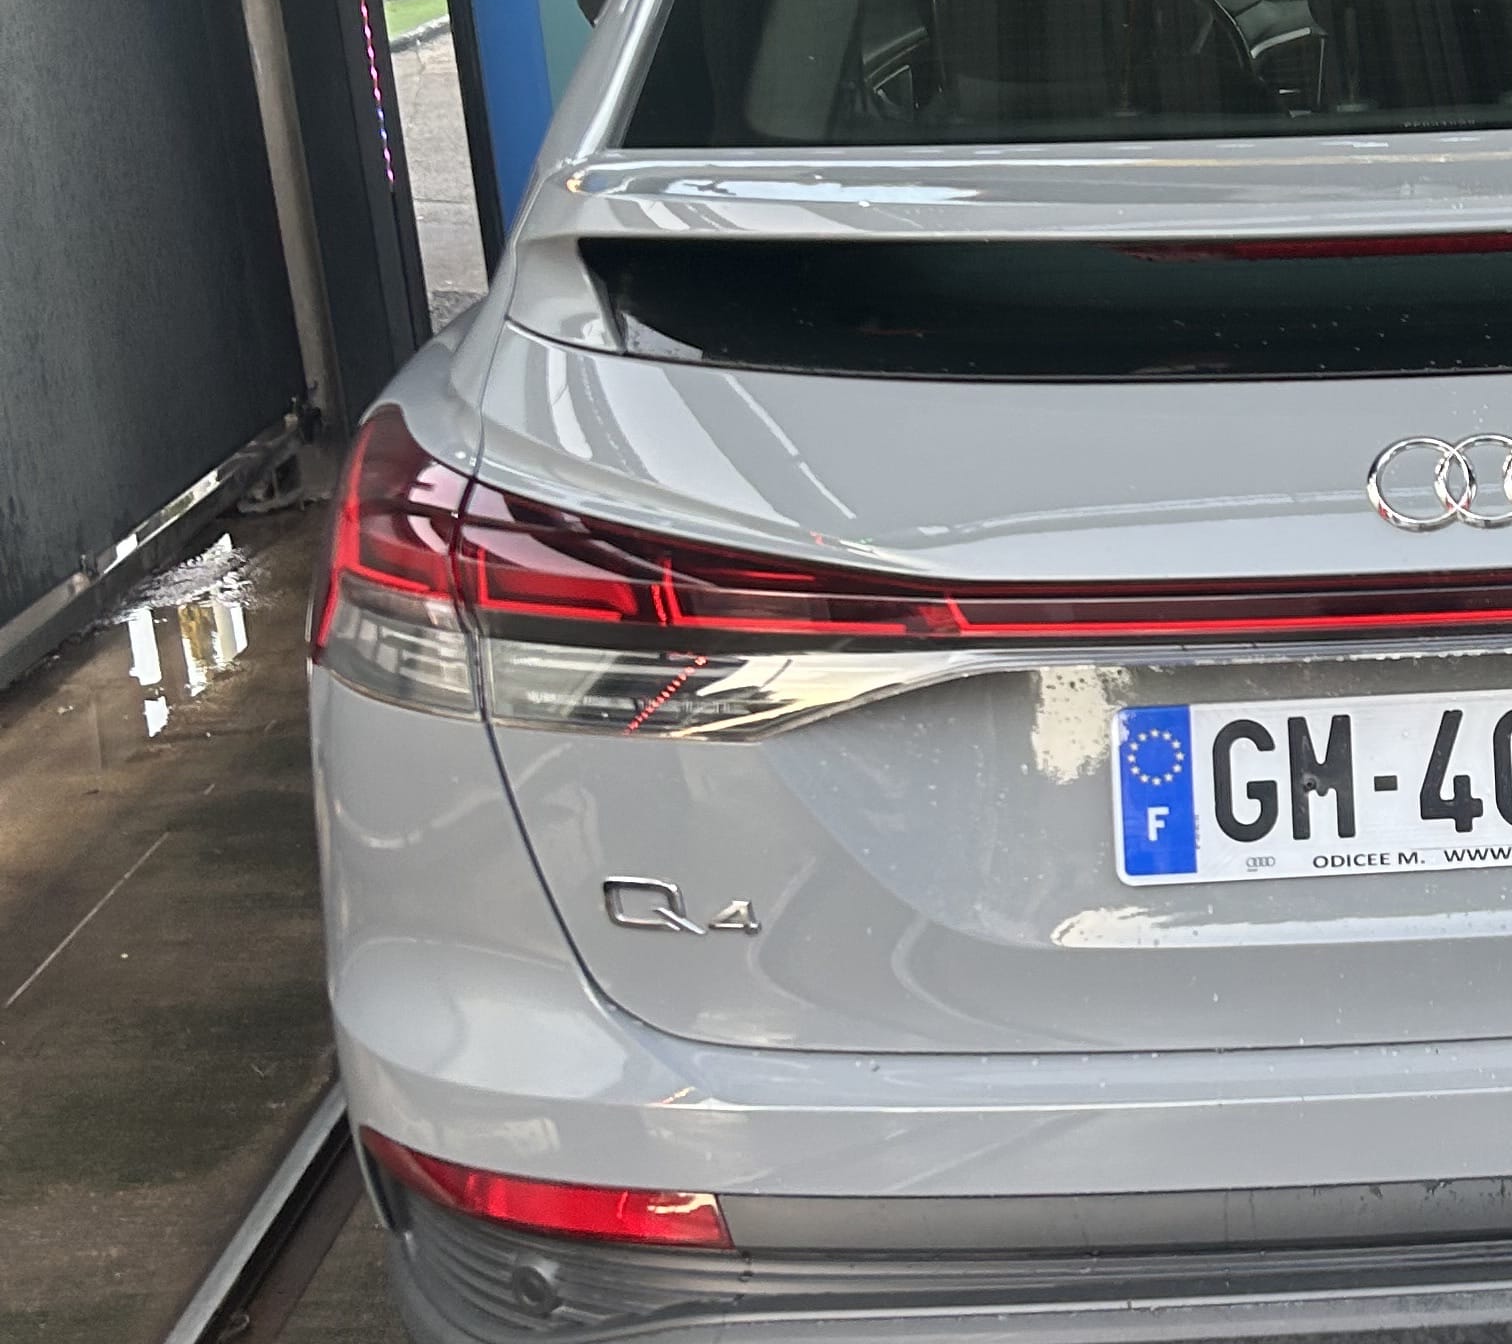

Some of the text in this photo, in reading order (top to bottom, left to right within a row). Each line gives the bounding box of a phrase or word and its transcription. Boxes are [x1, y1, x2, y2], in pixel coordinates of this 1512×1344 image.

[1147, 806, 1170, 842] F
[1313, 852, 1390, 868] ODICEE
[1398, 851, 1425, 865] M.
[603, 875, 762, 935] Q4
